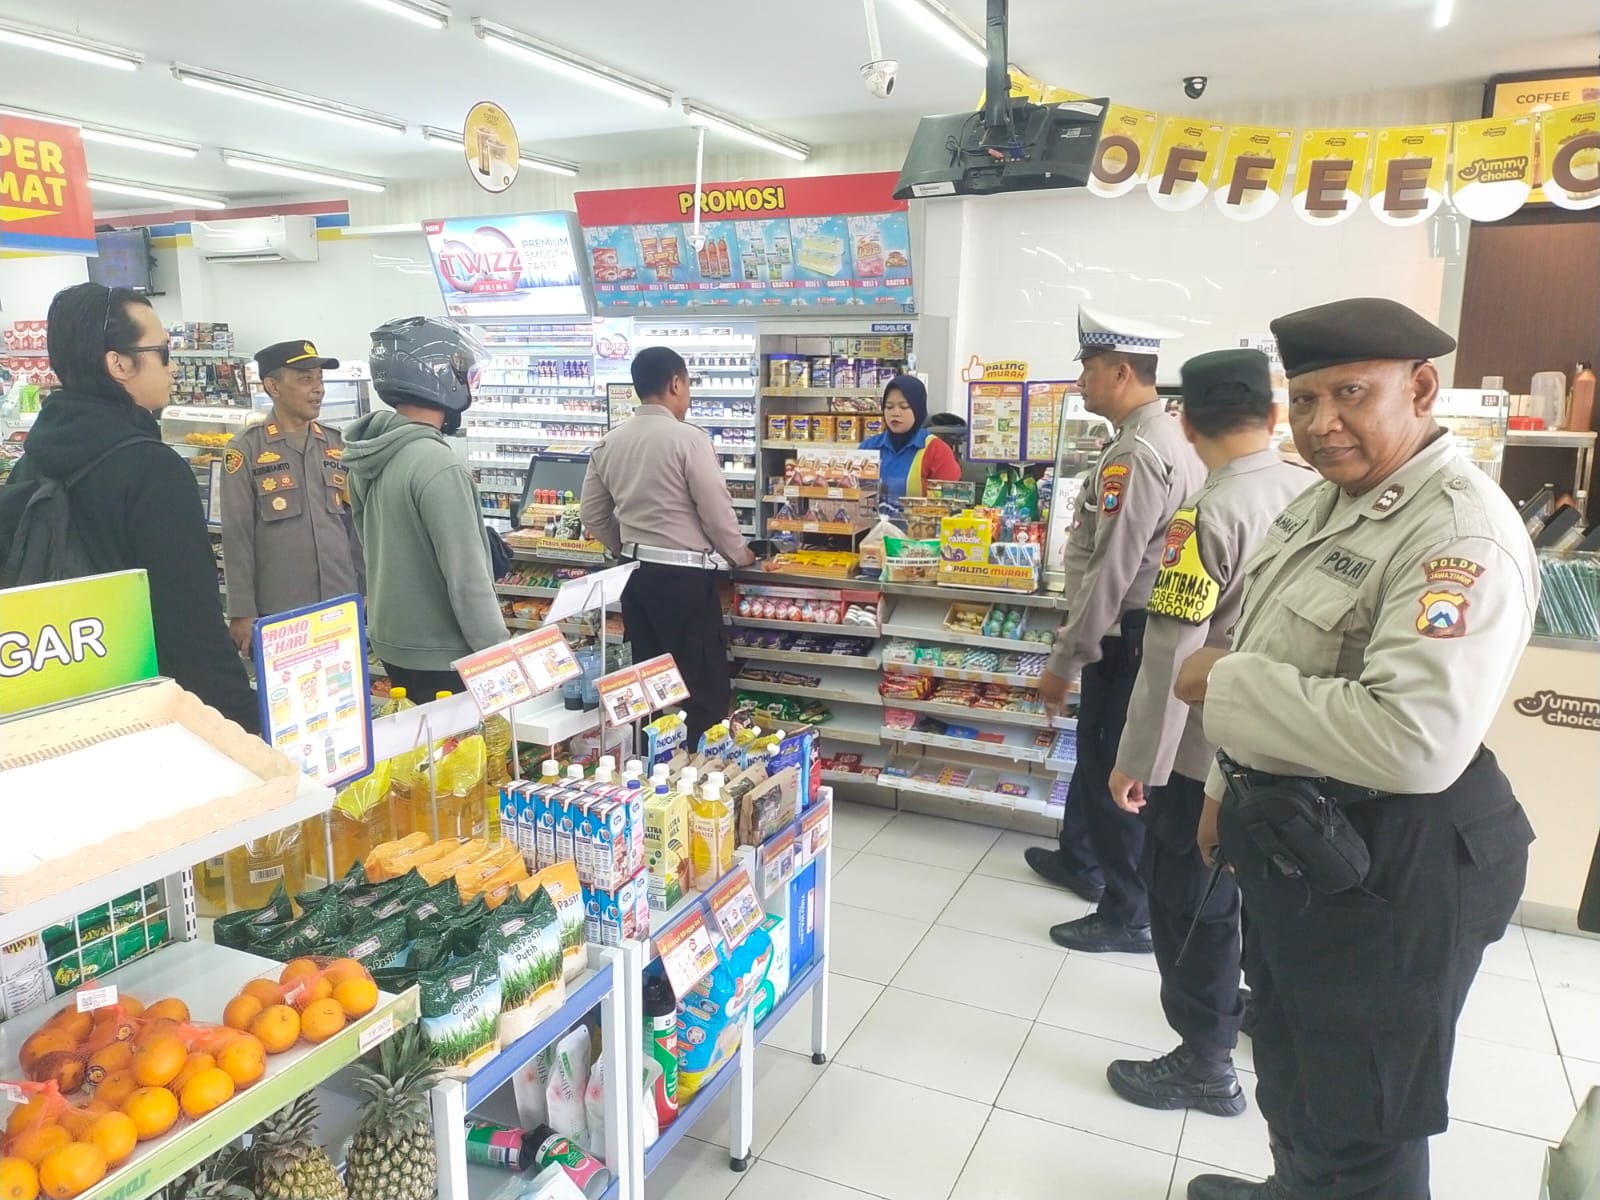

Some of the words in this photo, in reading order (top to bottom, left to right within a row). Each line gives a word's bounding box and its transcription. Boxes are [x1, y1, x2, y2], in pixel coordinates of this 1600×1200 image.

[1516, 91, 1571, 105] COFFEE
[1462, 157, 1527, 176] Yummy
[678, 186, 785, 216] PROMOSI
[521, 237, 569, 248] PREMIUM
[440, 250, 523, 278] TWIZZ
[528, 262, 558, 272] TASTE
[478, 284, 509, 292] PRIME
[901, 303, 915, 313] TS
[985, 363, 1025, 373] PALING
[986, 370, 1025, 379] MURAH
[953, 565, 989, 576] PALING
[990, 568, 1028, 579] MURAH
[1323, 551, 1368, 580] POLRI
[1429, 558, 1478, 575] POLDA
[262, 619, 310, 645] PROMO
[0, 617, 107, 678] GAR
[274, 632, 309, 656] HARI
[557, 891, 580, 914] Pasir
[520, 927, 542, 951] Pasir
[515, 944, 538, 967] Putih
[463, 983, 488, 1010] Pasir
